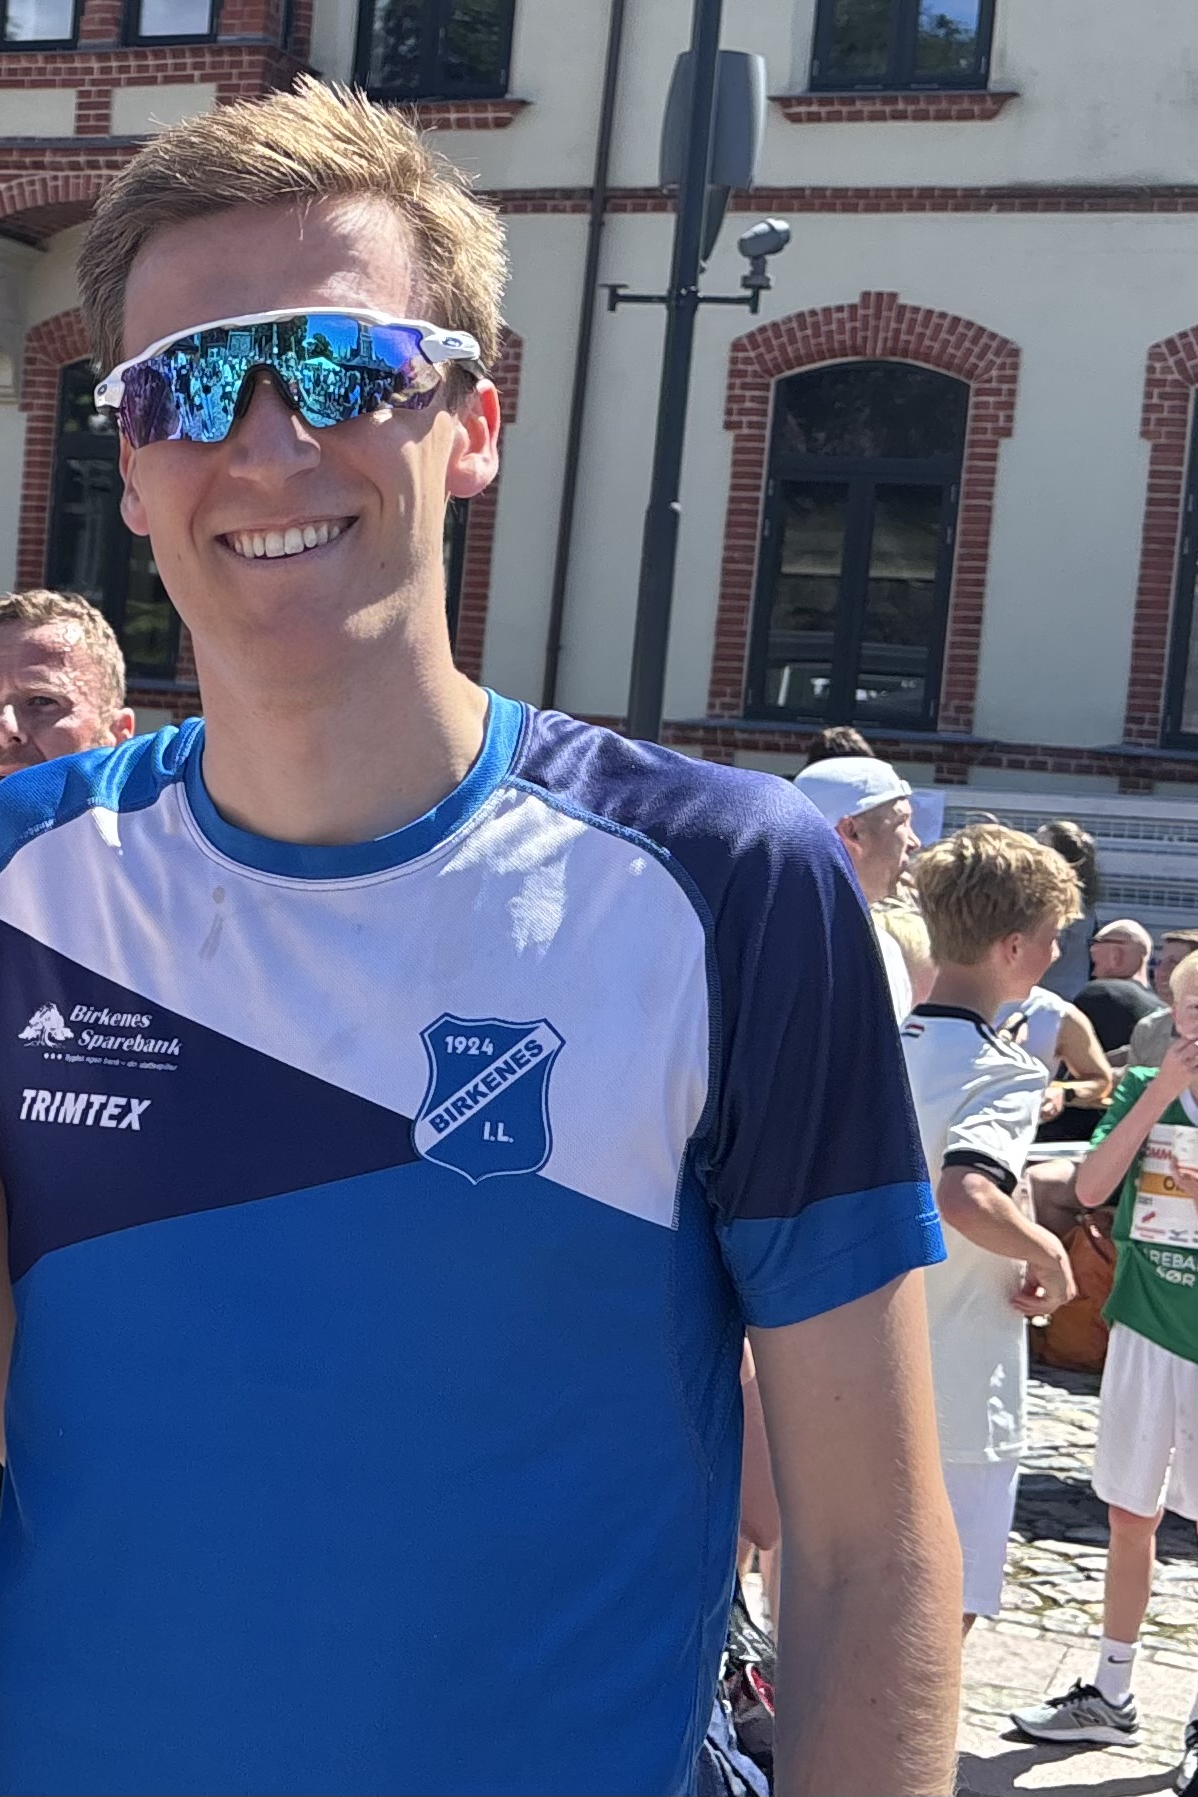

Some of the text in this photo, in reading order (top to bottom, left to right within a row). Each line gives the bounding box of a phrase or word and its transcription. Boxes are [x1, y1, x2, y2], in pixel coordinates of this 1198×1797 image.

[70, 1004, 152, 1028] Birkenes
[78, 1029, 182, 1056] Sparebank
[445, 1036, 494, 1056] 1924
[428, 1039, 544, 1134] BIRKENES
[20, 1089, 151, 1130] TRIMTEX
[483, 1121, 514, 1143] I.L.
[1144, 1248, 1198, 1273] REBA
